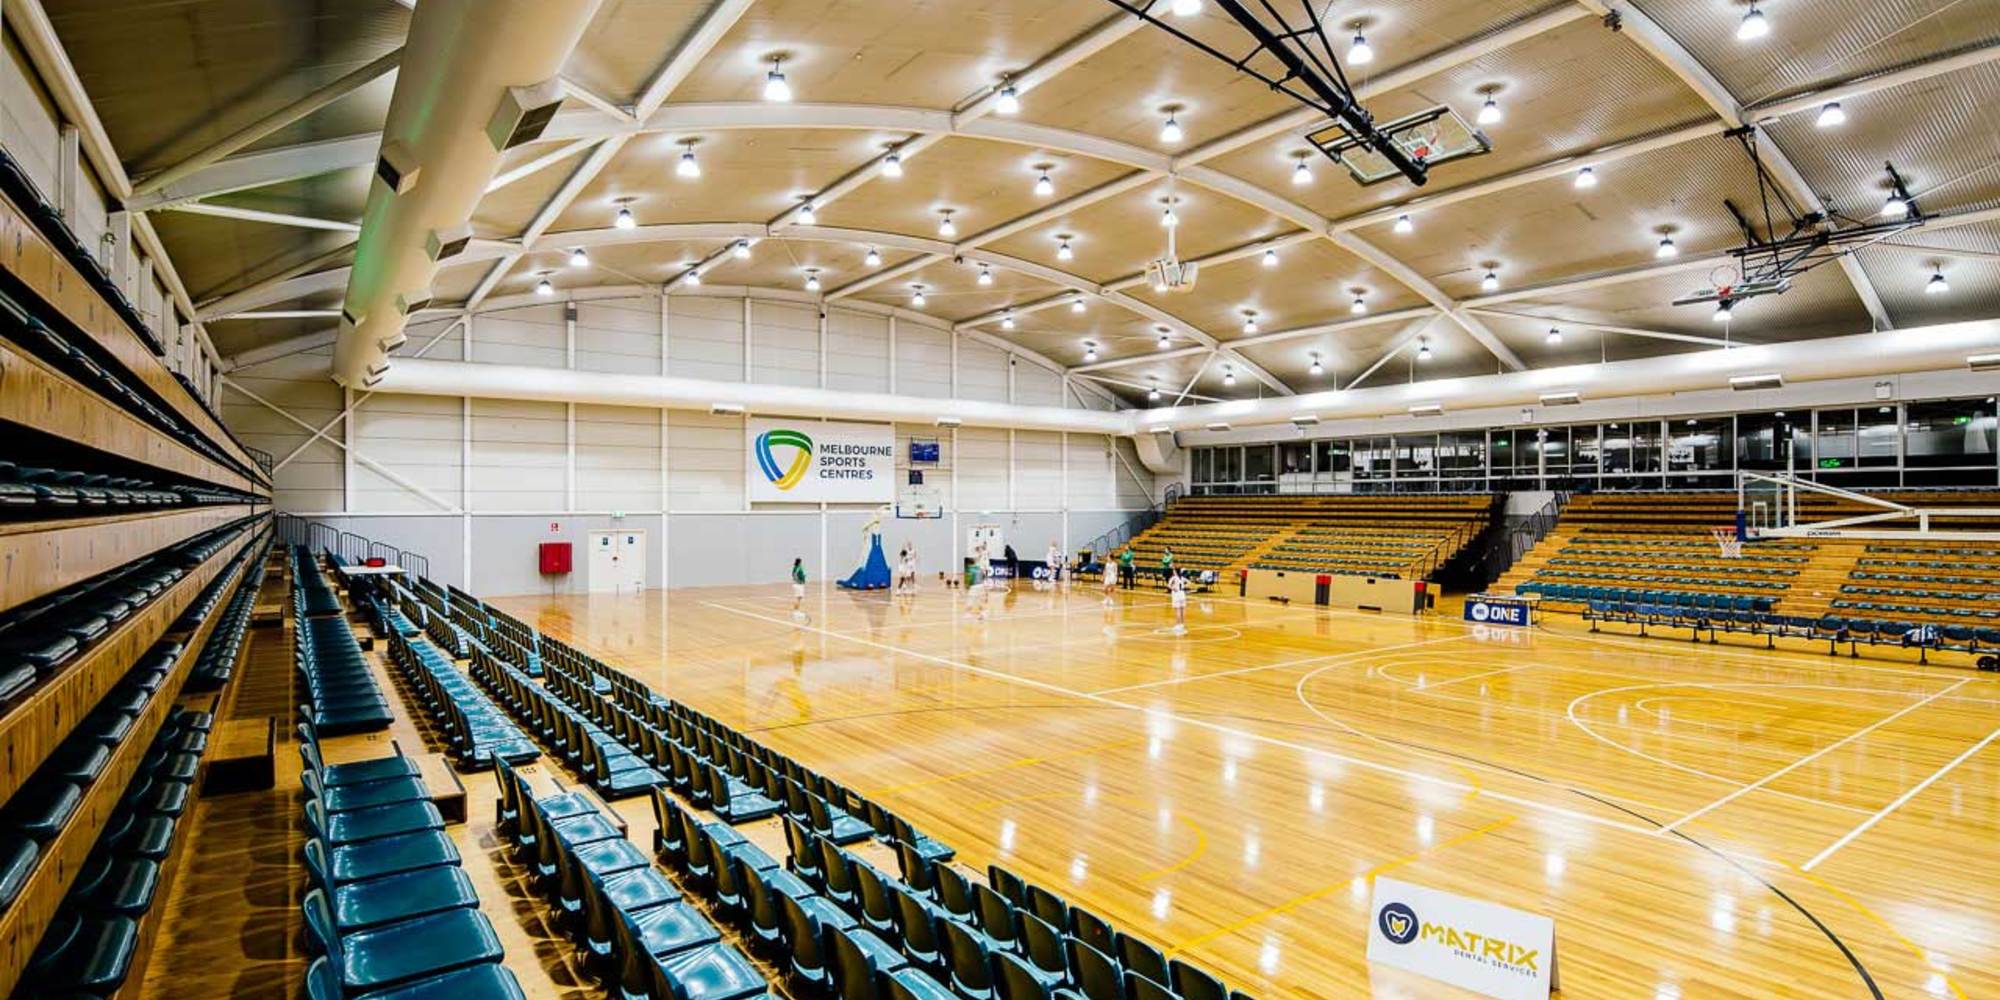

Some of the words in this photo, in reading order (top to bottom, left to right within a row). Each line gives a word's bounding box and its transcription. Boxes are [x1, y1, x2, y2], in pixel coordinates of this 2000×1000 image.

[819, 444, 893, 456] MELBOURNE
[819, 456, 867, 468] SPORTS
[819, 469, 873, 480] CENTRES
[1491, 606, 1520, 622] ONE
[1421, 922, 1539, 970] MATRIX
[1454, 949, 1488, 964] DENTAL
[1492, 960, 1538, 978] SERVICES
